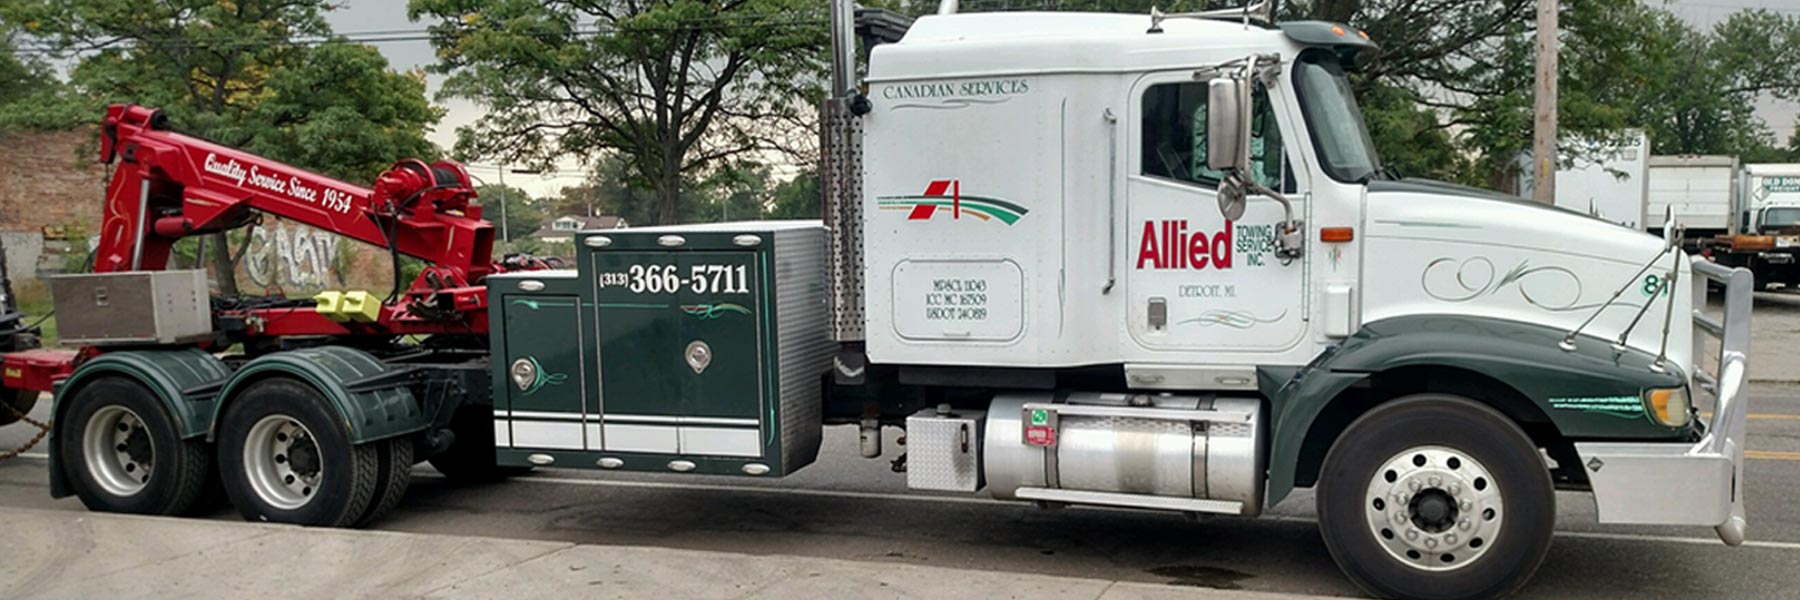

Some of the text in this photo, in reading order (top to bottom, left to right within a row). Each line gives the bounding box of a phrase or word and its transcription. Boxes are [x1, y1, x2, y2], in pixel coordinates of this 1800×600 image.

[883, 79, 1029, 99] CANADIAN SERVICES
[204, 152, 352, 214] Quality Service Since 1954
[1763, 177, 1780, 186] OLD
[1236, 224, 1272, 238] TOWING
[1136, 218, 1233, 270] Allied
[1236, 238, 1272, 253] SERVICE
[1247, 253, 1265, 266] INC.
[629, 264, 749, 294] 366-5711
[1643, 274, 1668, 295] 81
[926, 293, 942, 305] ICC
[944, 293, 958, 305] MC
[926, 307, 955, 320] USDOT
